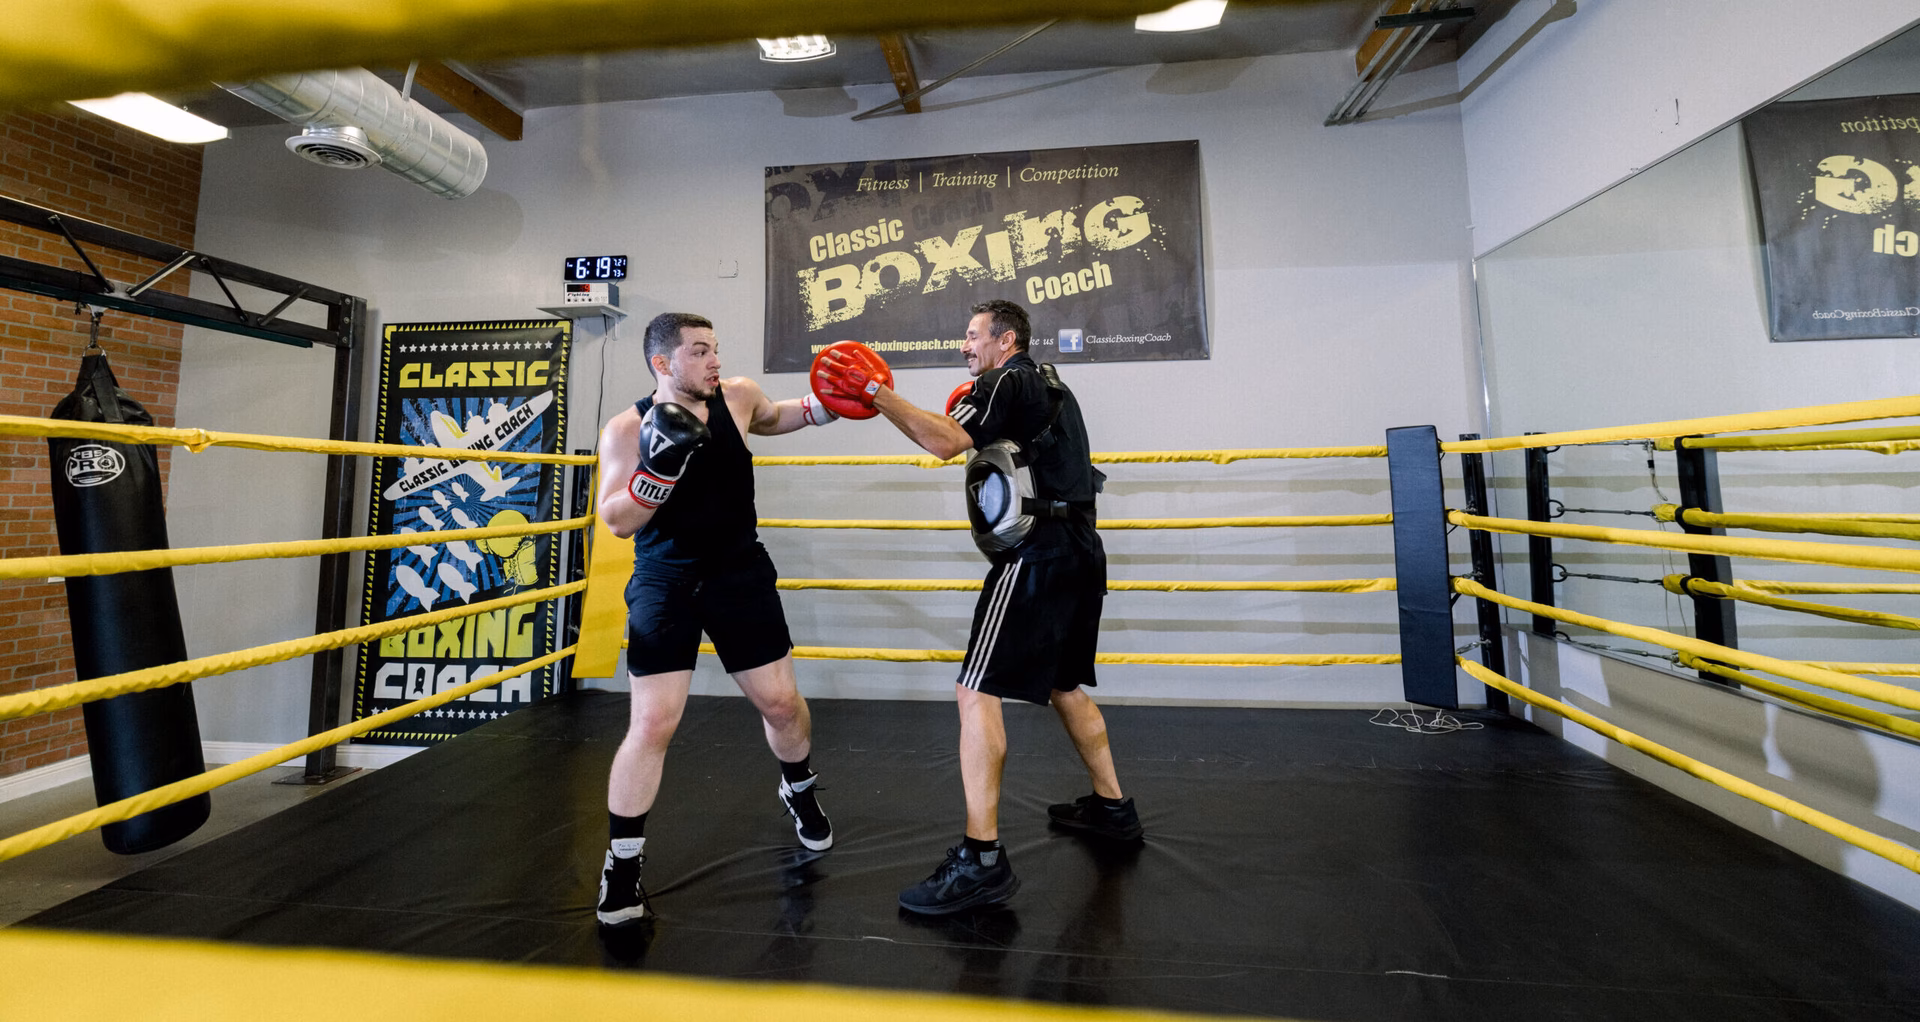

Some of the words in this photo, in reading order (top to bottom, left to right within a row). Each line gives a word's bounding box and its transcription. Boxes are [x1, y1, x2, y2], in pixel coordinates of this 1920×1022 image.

[856, 176, 910, 192] Fitness
[932, 170, 999, 189] Training
[1019, 163, 1120, 184] Competition
[809, 218, 905, 263] Classic
[576, 256, 611, 279] 6:19
[1025, 260, 1114, 305] Coach
[1043, 338, 1054, 346] us
[1085, 332, 1172, 345] ClassicBoxingCoach
[398, 360, 550, 389] CLASSIC
[399, 462, 449, 493] CLASSIC
[494, 403, 535, 441] COACH
[637, 479, 670, 501] TITLE
